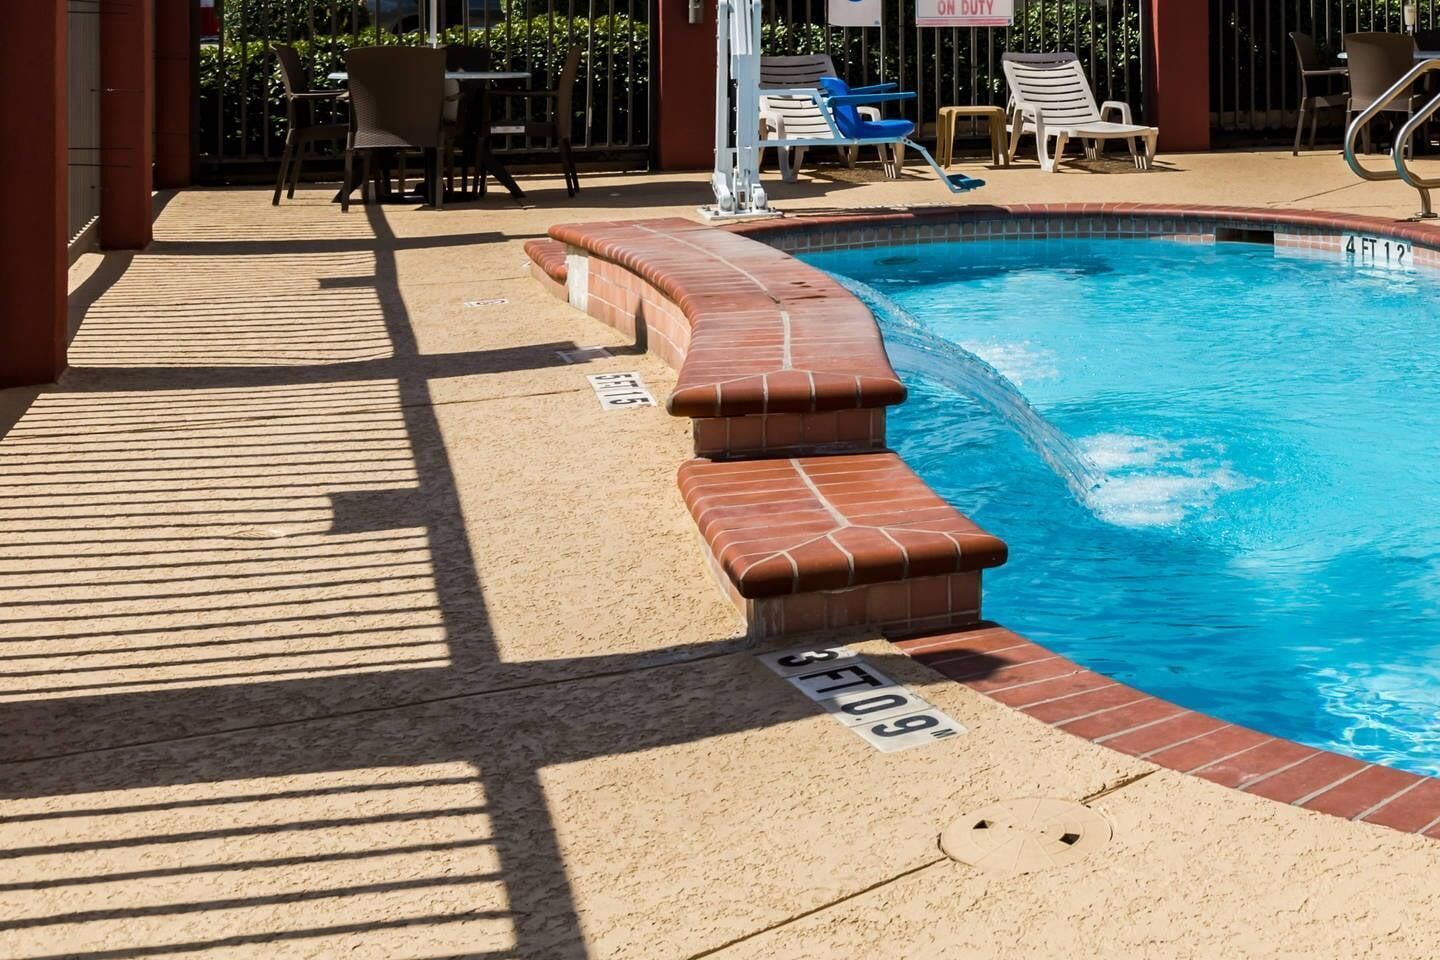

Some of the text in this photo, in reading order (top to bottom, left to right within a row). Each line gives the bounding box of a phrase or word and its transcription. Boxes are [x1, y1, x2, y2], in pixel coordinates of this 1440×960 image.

[937, 0, 994, 15] ON DUTY
[1345, 235, 1356, 254] 4
[1361, 237, 1377, 258] FT
[776, 649, 839, 669] 3
[798, 664, 883, 694] FT
